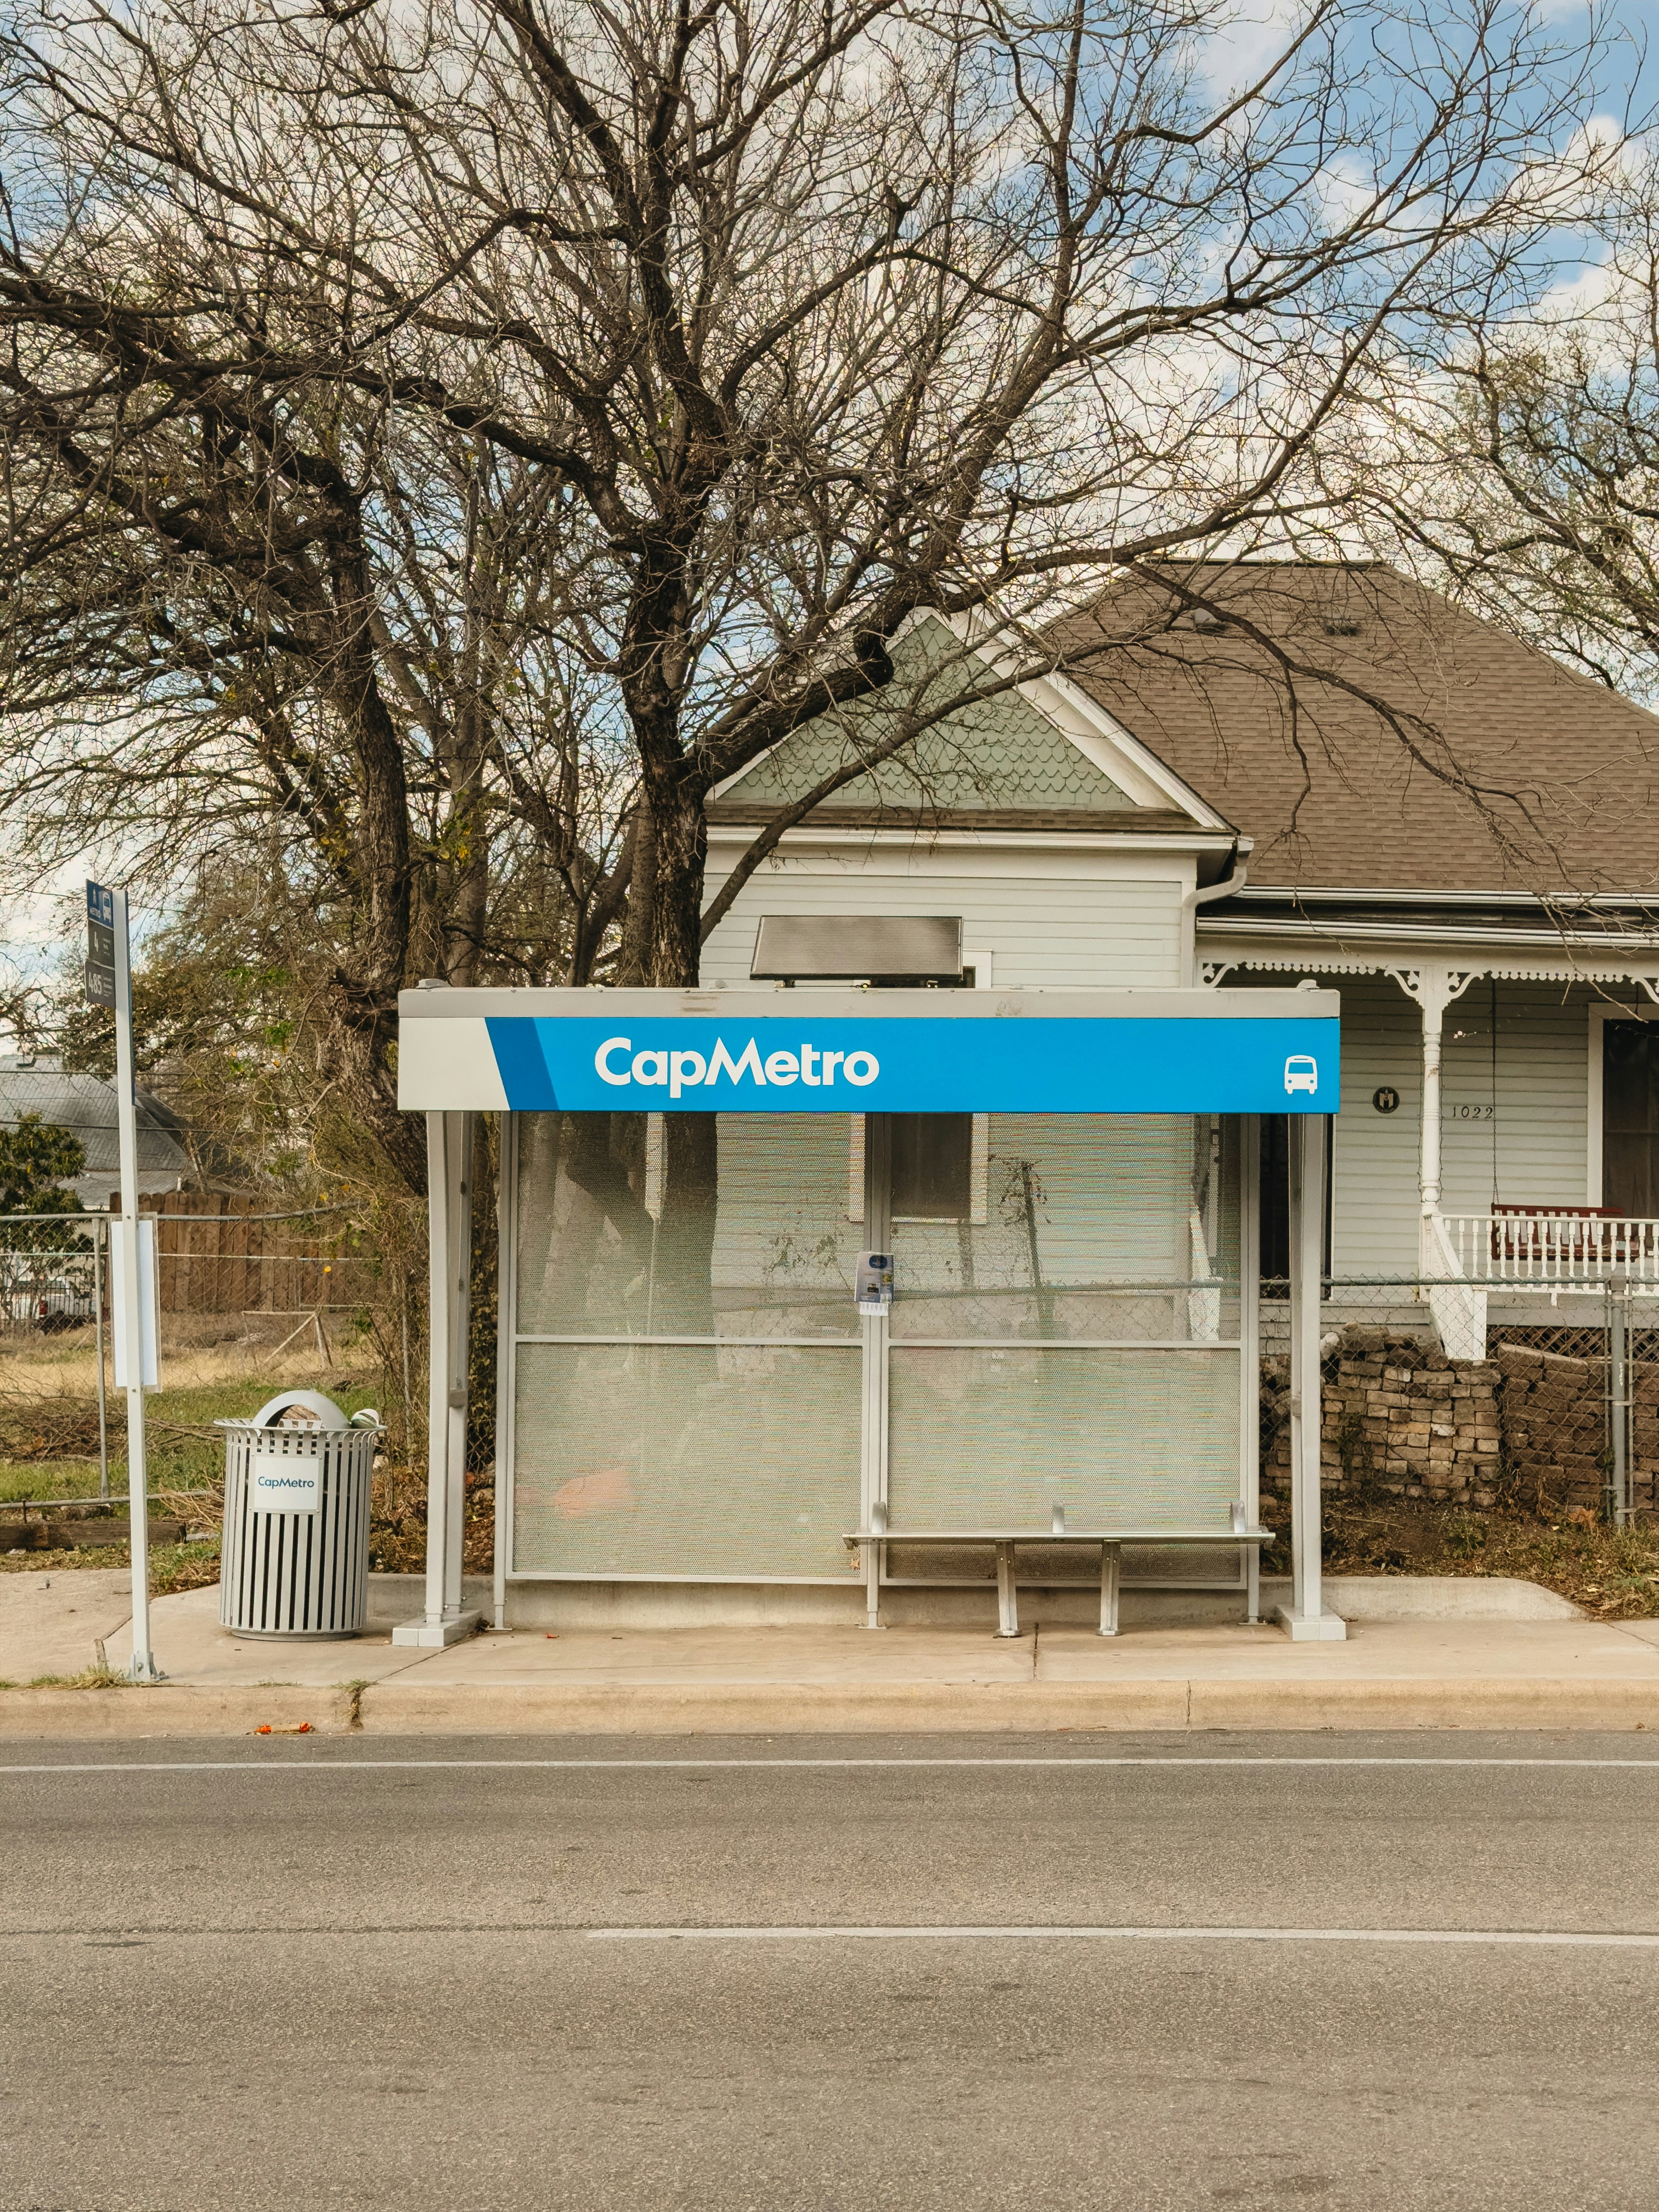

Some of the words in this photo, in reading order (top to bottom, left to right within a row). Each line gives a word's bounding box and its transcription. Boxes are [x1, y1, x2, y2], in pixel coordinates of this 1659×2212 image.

[94, 931, 99, 952] 4
[88, 972, 102, 995] 485
[594, 1036, 880, 1098] CapMetro
[1453, 1105, 1493, 1119] 1022
[258, 1476, 315, 1489] CapMetro
